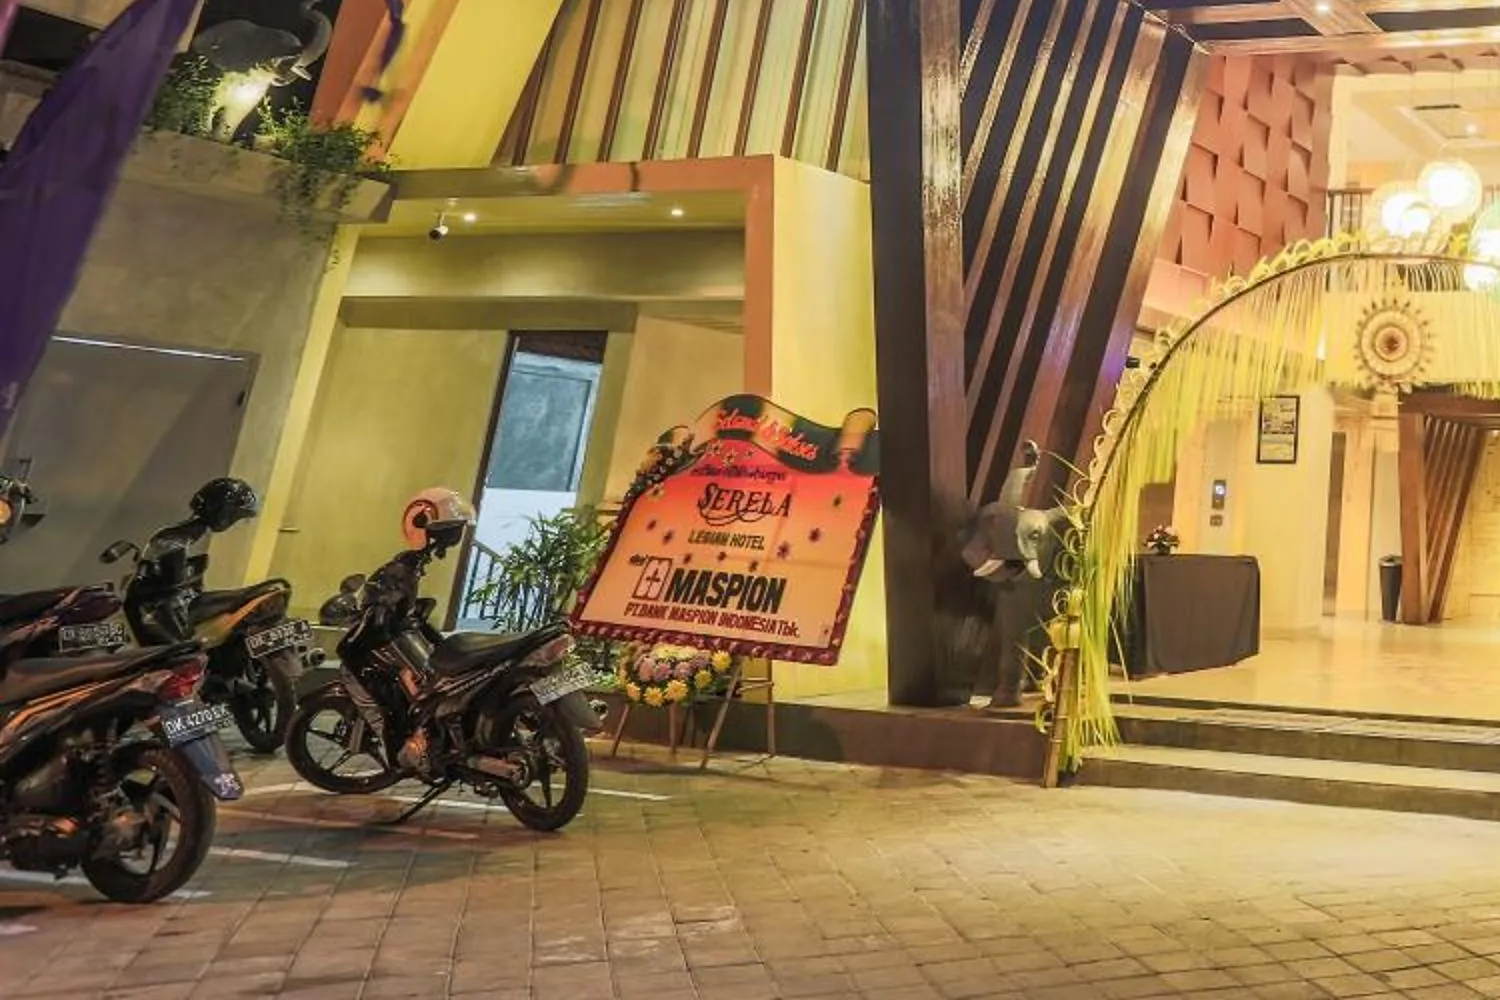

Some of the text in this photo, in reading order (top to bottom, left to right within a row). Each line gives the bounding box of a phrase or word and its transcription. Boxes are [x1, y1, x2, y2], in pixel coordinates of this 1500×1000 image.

[697, 482, 792, 527] SERELA
[729, 533, 765, 550] HOTEL
[663, 567, 787, 615] MASPION
[667, 606, 718, 628] MASPION
